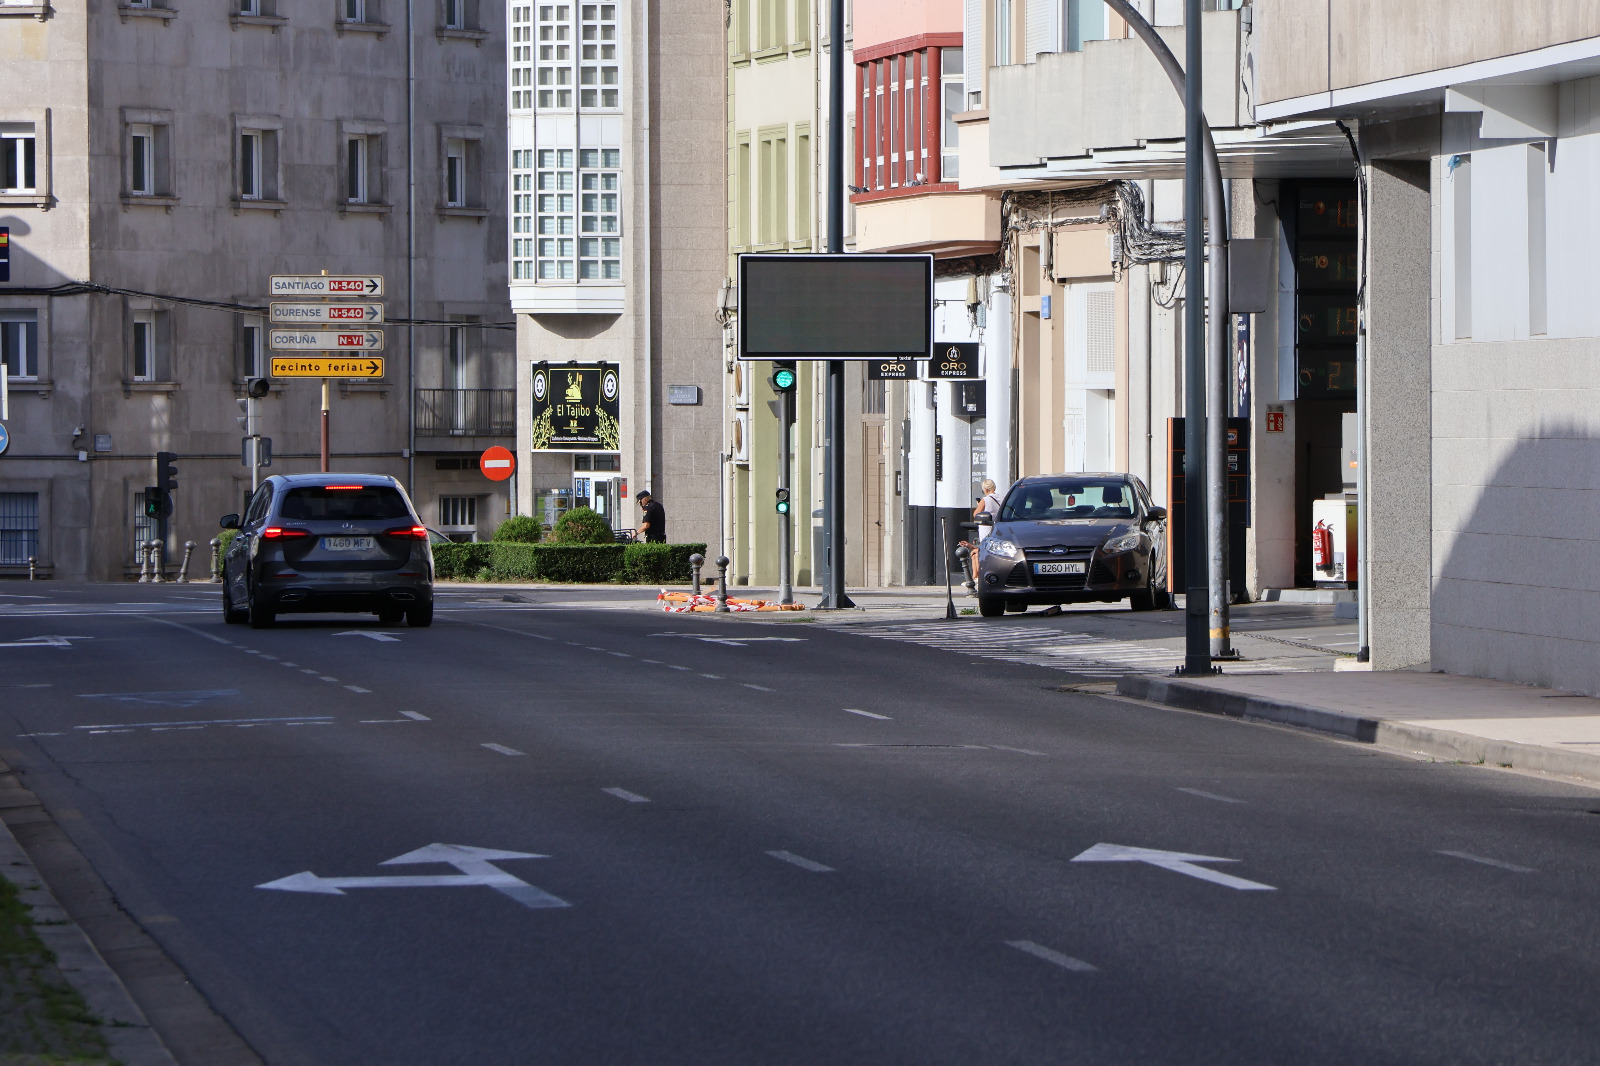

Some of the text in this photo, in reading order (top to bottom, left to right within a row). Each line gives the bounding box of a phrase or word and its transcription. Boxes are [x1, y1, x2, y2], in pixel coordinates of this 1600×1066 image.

[274, 281, 363, 290] SANTIAGO N-540
[274, 308, 362, 317] OURENSE N-540
[274, 334, 362, 345] CORUÑA N-VI
[274, 362, 363, 371] recinto ferial
[880, 363, 906, 372] ORO
[940, 362, 967, 370] ORO
[556, 404, 591, 419] El Tajibo
[328, 538, 351, 548] 1460
[1041, 564, 1063, 573] 8260
